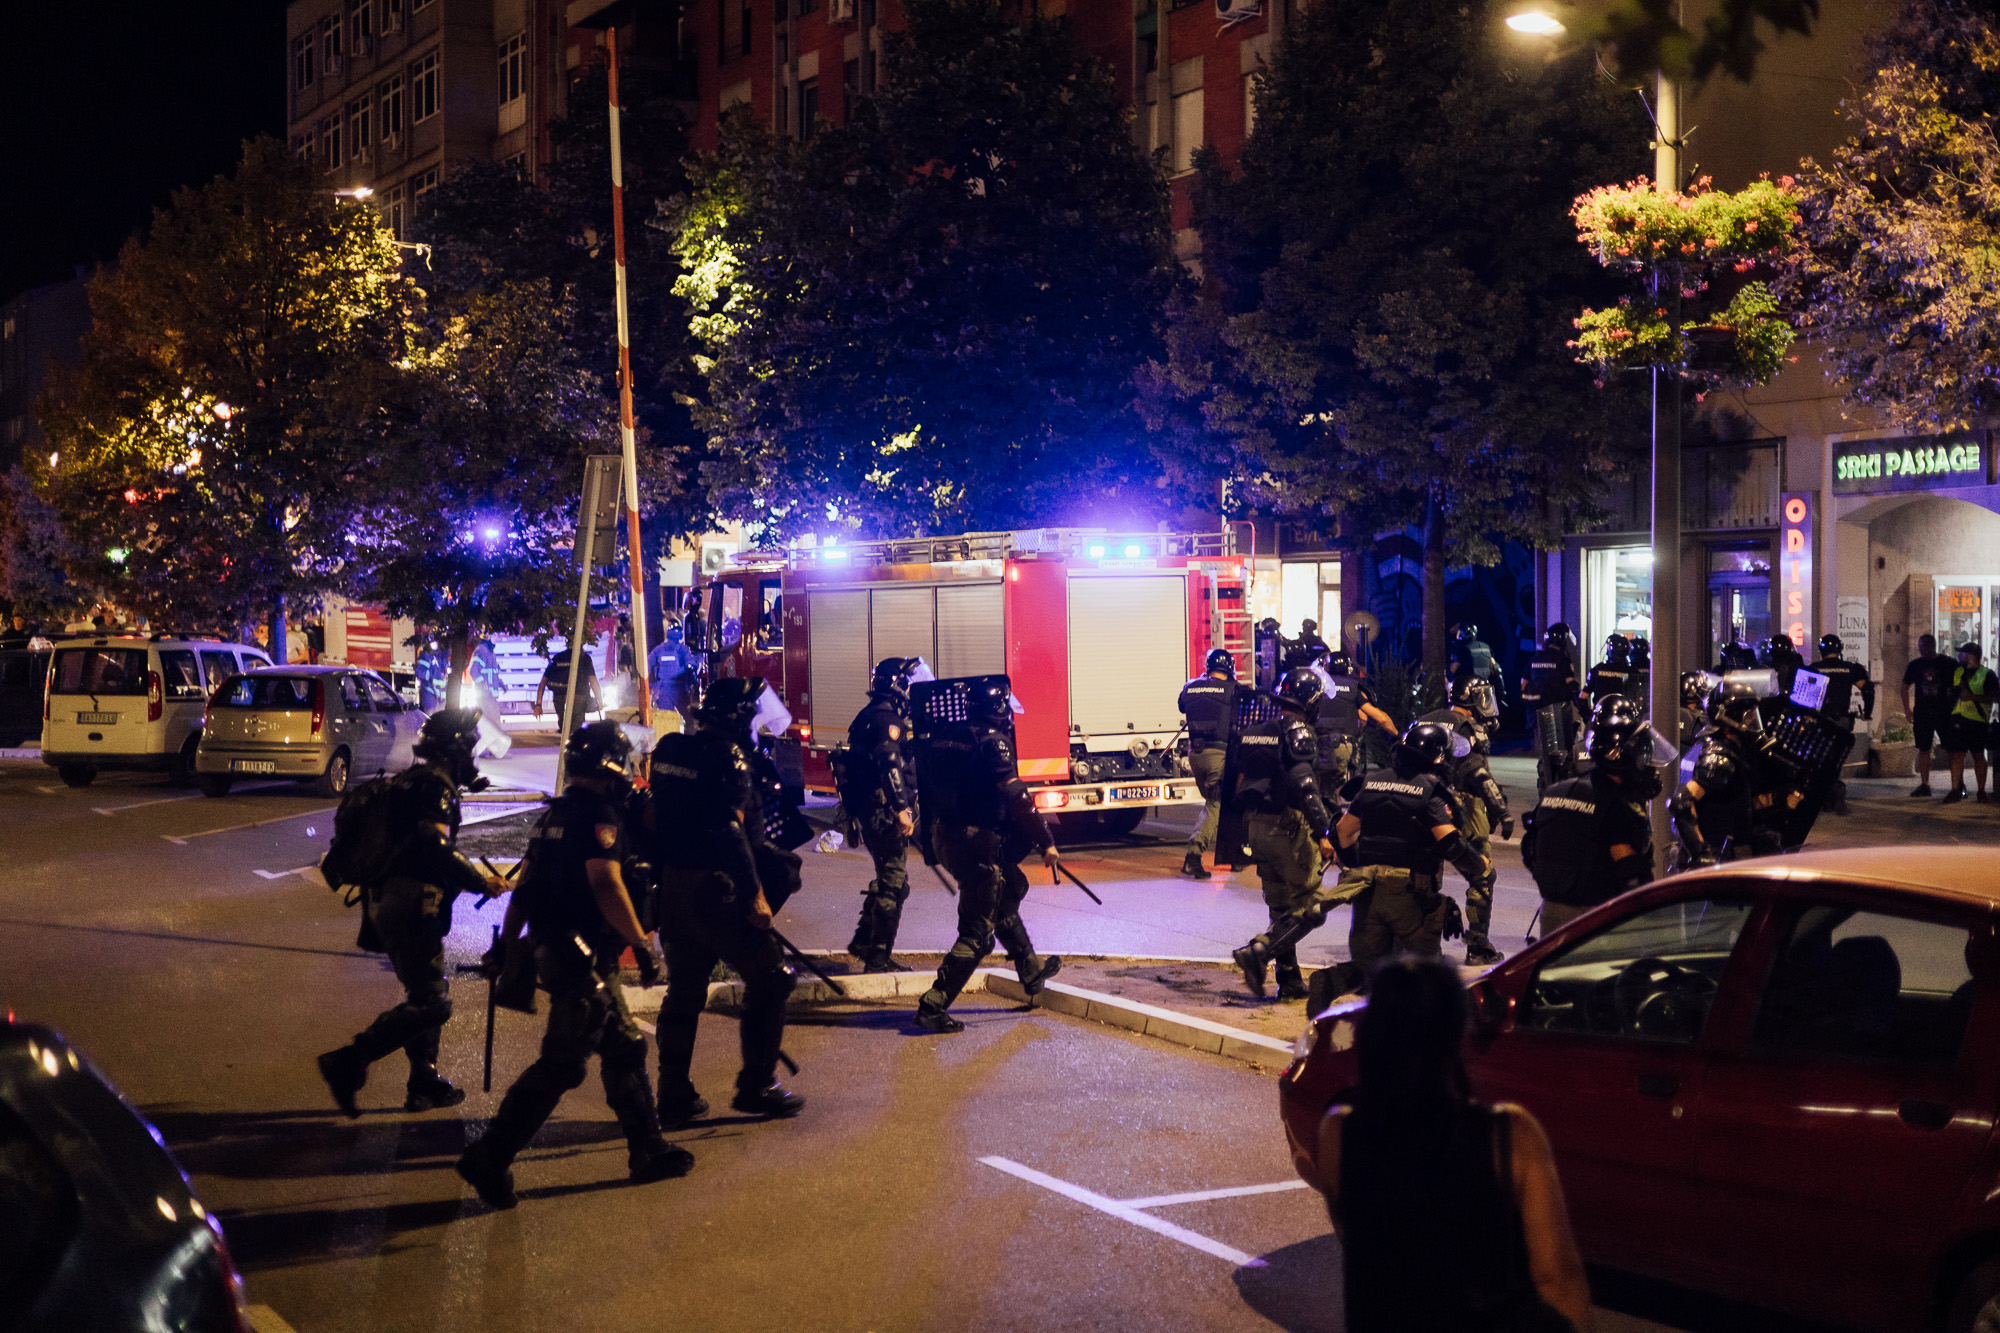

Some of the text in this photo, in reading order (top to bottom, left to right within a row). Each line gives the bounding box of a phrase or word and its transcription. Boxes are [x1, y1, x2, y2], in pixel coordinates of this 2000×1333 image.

[1837, 443, 1980, 480] SRKI PASSAGE
[1939, 596, 1981, 608] SRKI
[793, 615, 803, 626] 193
[1839, 613, 1867, 629] LUNA
[1365, 781, 1424, 796] ЖАНДАРМЕРИЈА
[1070, 793, 1087, 801] IVEC
[1541, 797, 1597, 815] ЖАНДАРМЕРИЈА
